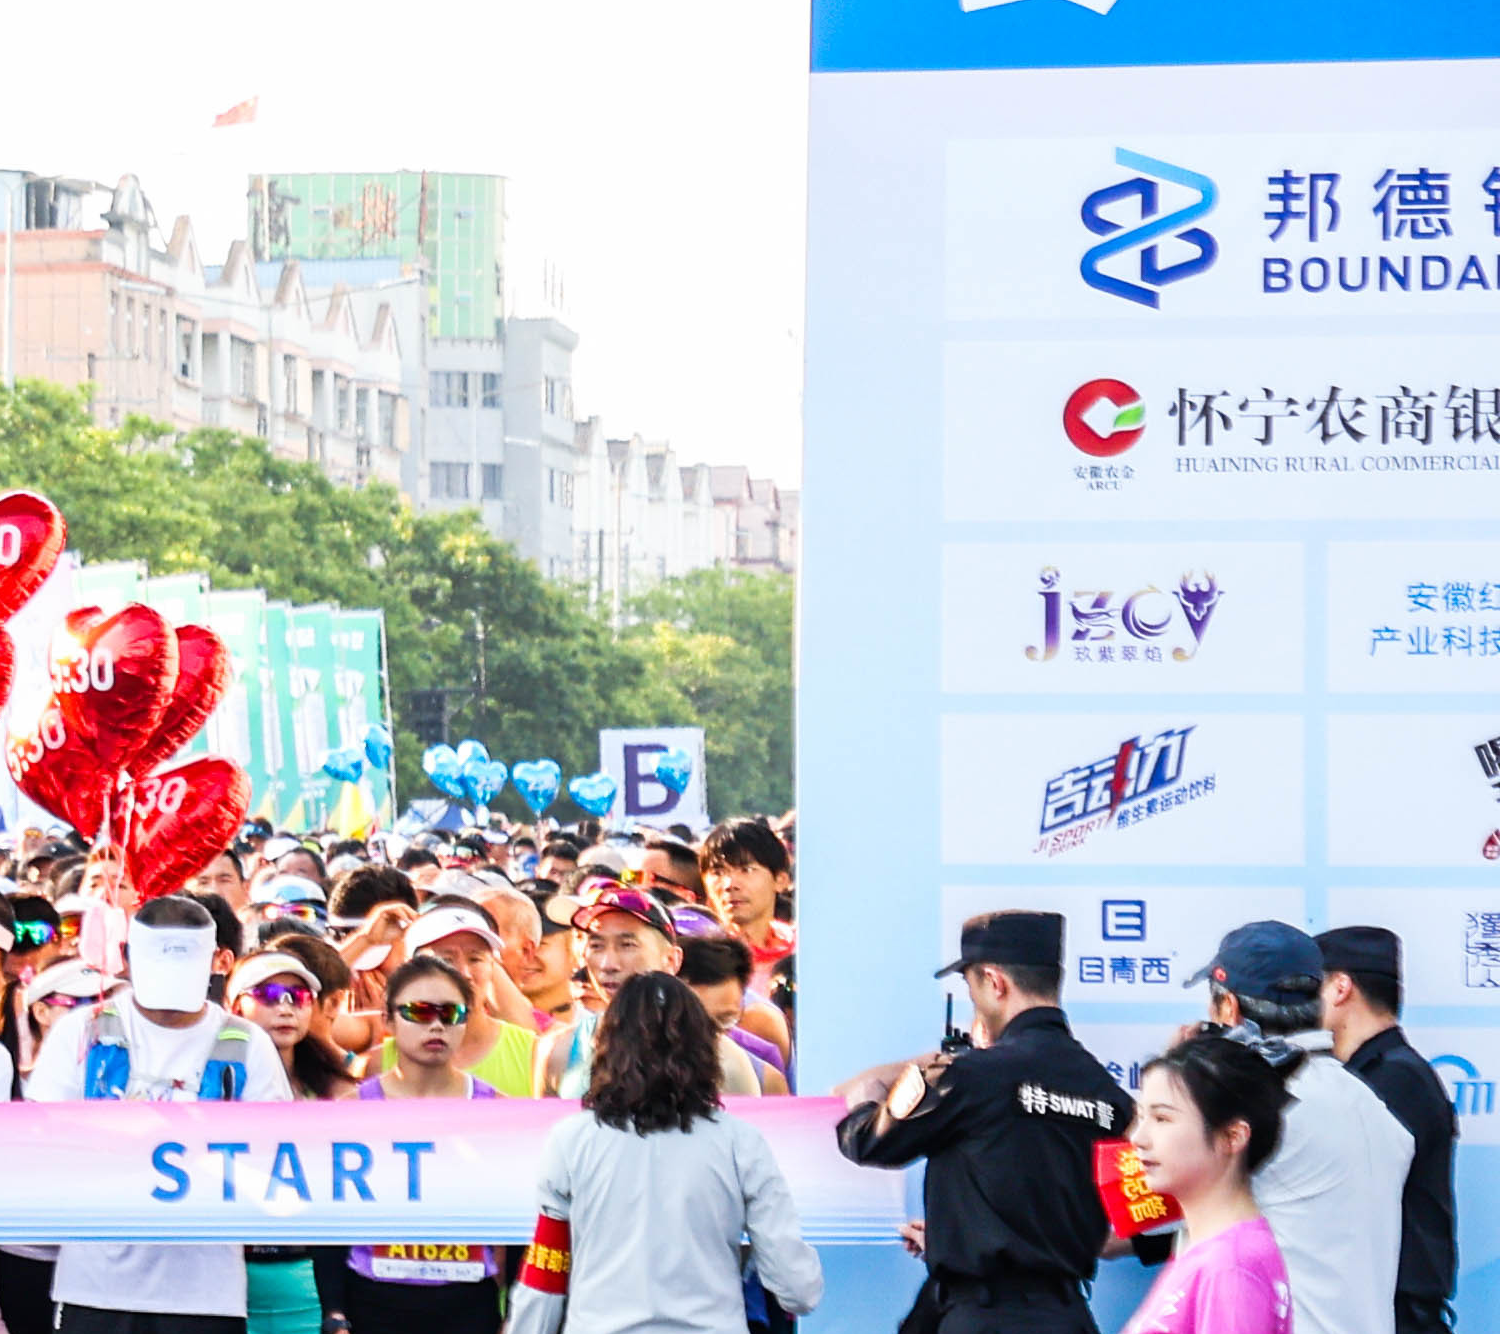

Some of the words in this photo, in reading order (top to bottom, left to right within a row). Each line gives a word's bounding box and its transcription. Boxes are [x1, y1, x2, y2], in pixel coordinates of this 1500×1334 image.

[1263, 254, 1500, 293] BOUNDA
[1176, 456, 1277, 473] HUAINING
[1285, 455, 1349, 473] RURAL
[134, 776, 187, 816] 30
[623, 744, 683, 815] B
[150, 1140, 435, 1204] START
